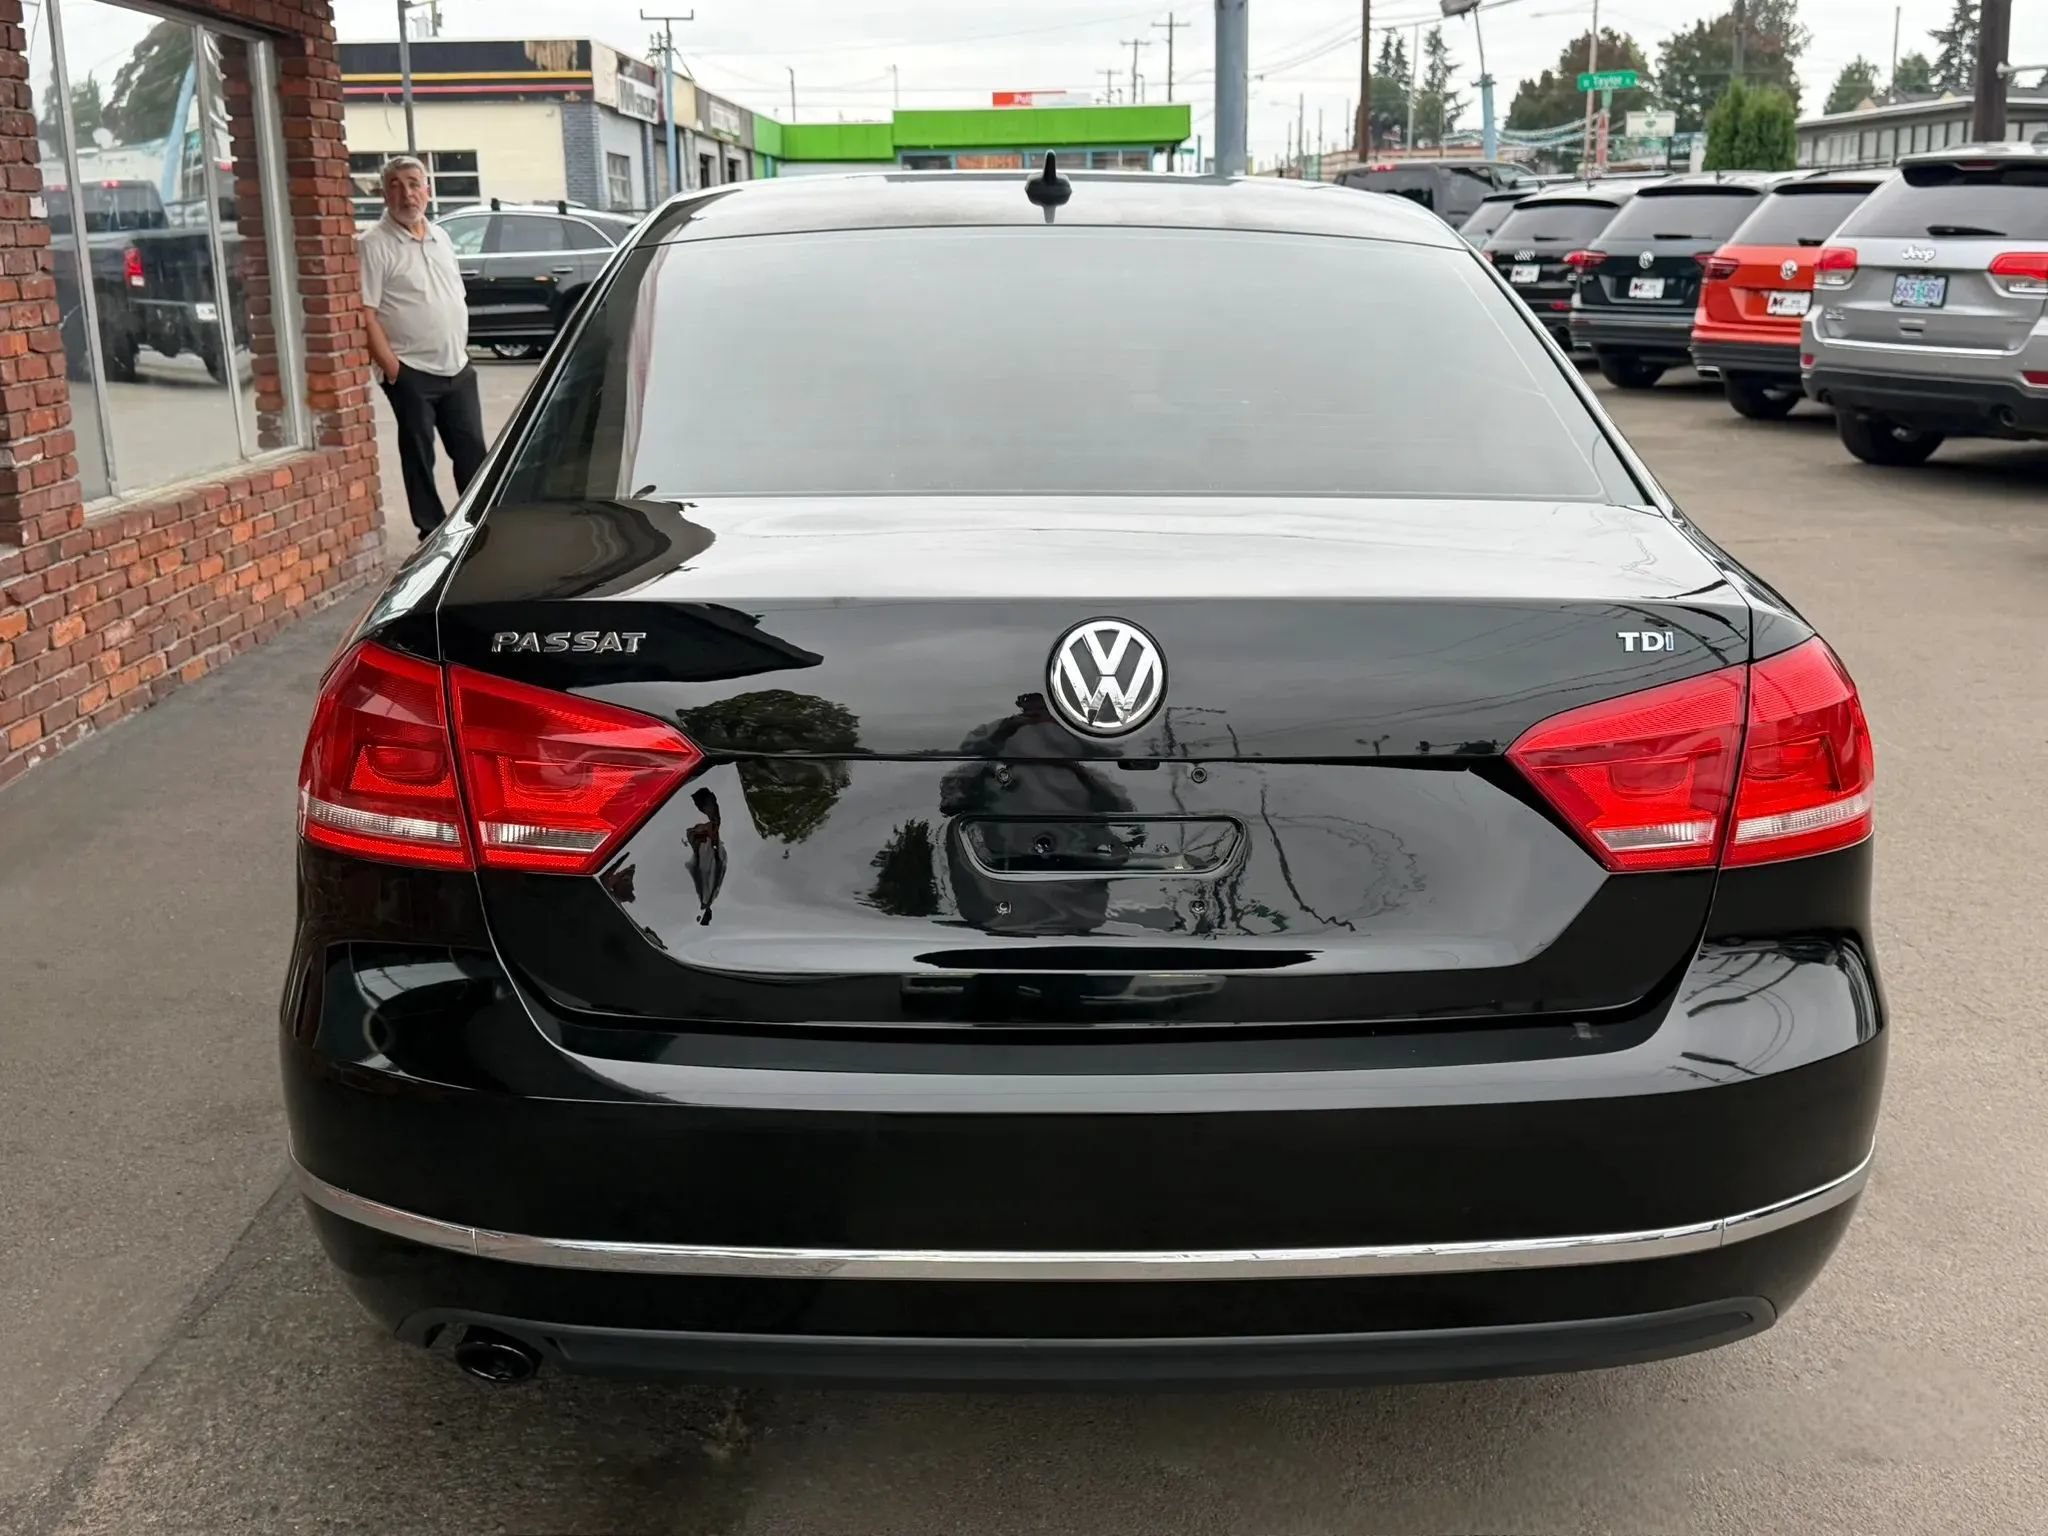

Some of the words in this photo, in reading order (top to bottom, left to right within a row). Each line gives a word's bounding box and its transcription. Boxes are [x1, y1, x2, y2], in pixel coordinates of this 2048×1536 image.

[1901, 246, 1936, 262] Jeep
[491, 631, 647, 653] PASSAT
[1616, 631, 1674, 652] TDI
